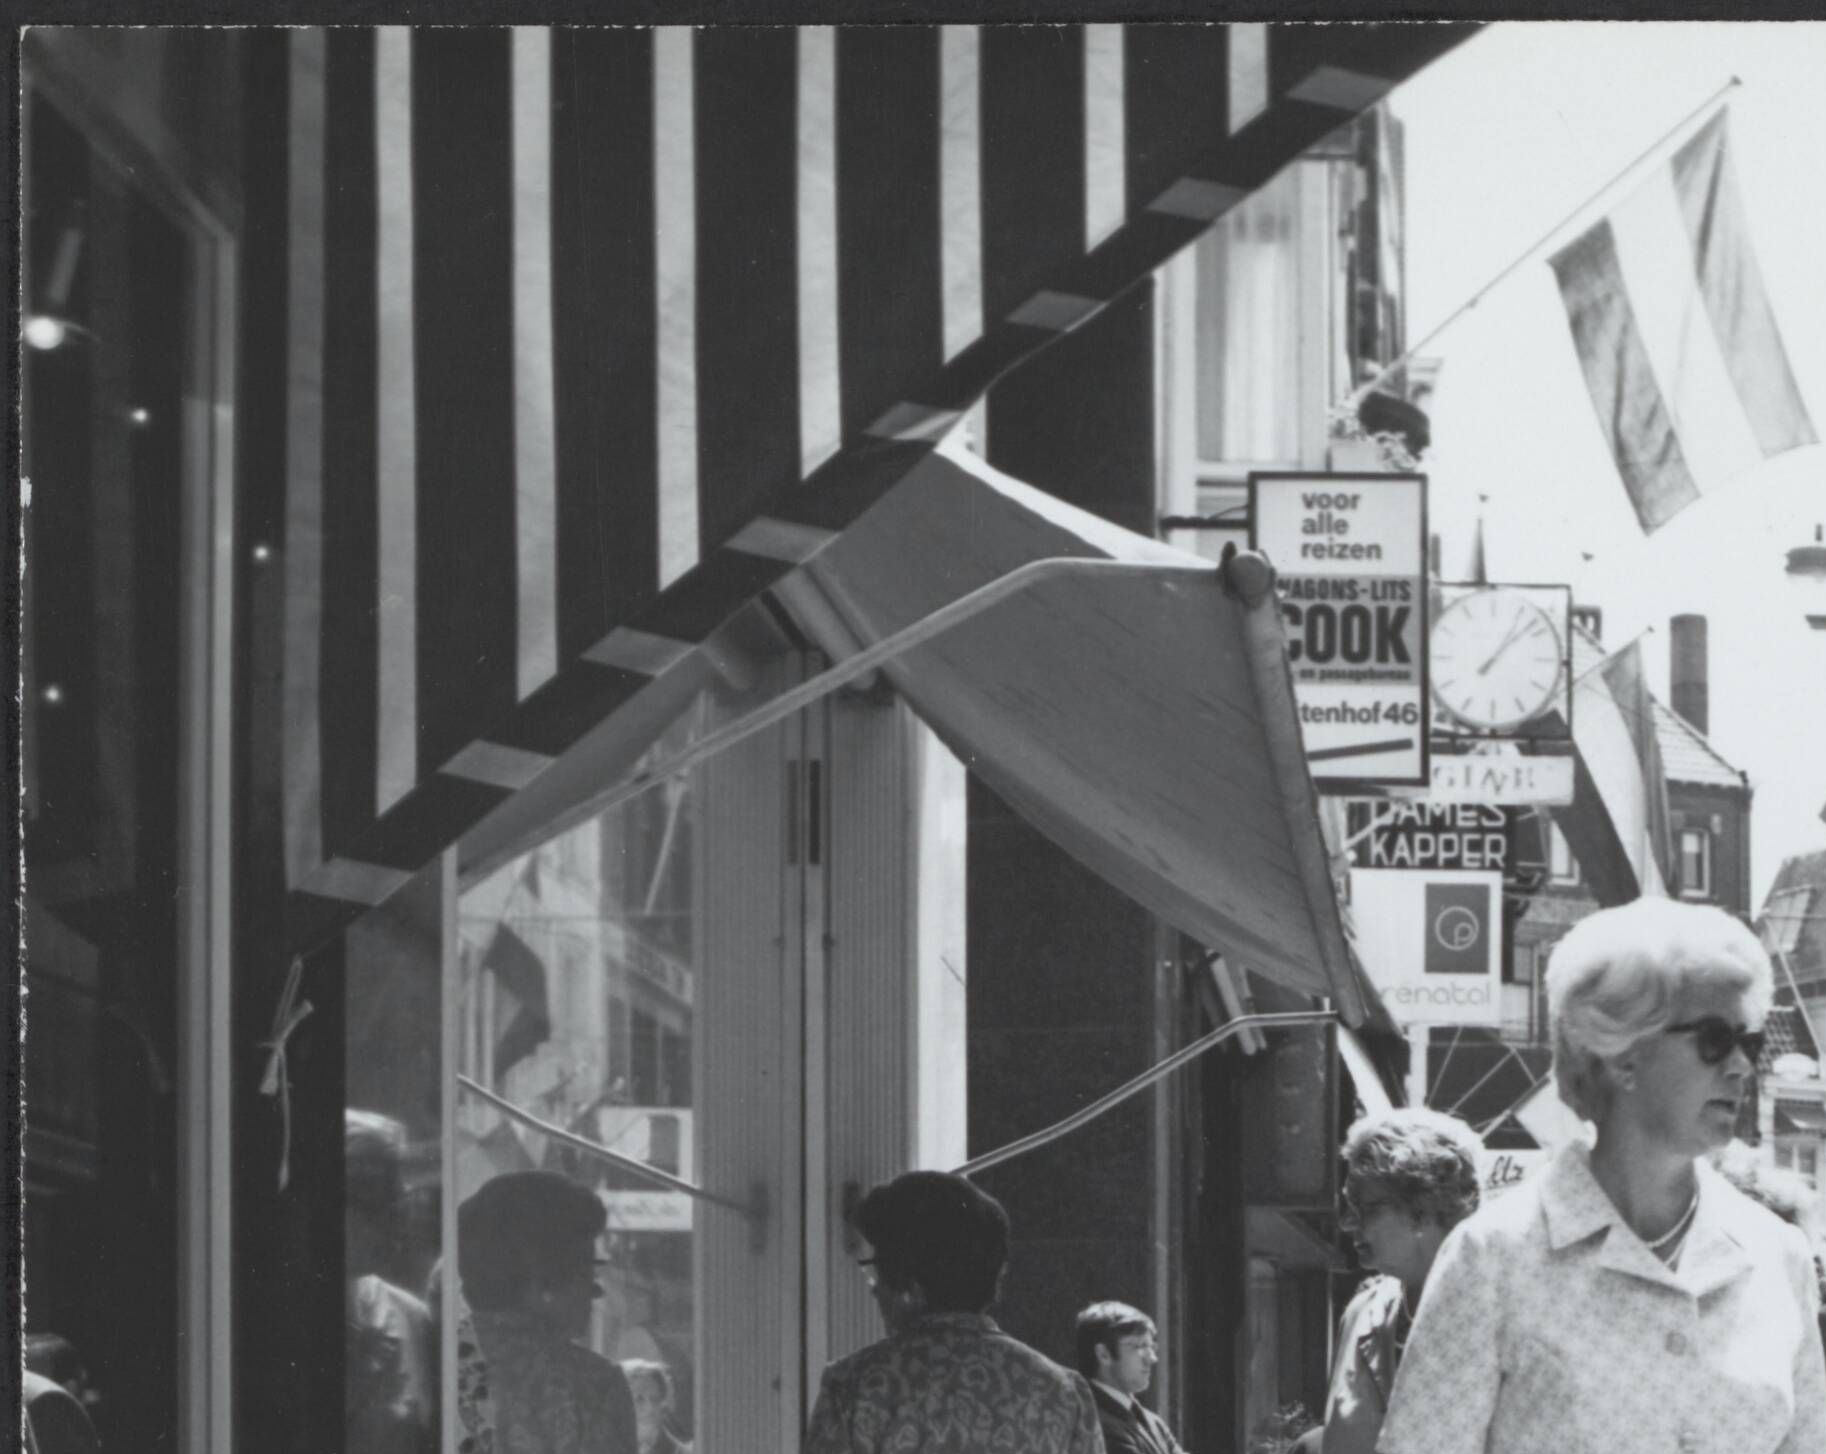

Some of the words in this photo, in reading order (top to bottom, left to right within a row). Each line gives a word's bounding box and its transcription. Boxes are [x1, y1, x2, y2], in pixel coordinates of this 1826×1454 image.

[1301, 492, 1362, 511] voor
[1301, 511, 1350, 535] alle
[1301, 535, 1383, 561] reizen
[1281, 603, 1412, 665] COOK
[1301, 700, 1381, 724] tenhof
[1383, 702, 1419, 725] 46
[1370, 800, 1507, 828] DAMES
[1370, 832, 1507, 868] KAPPER
[1380, 981, 1492, 1005] renatal
